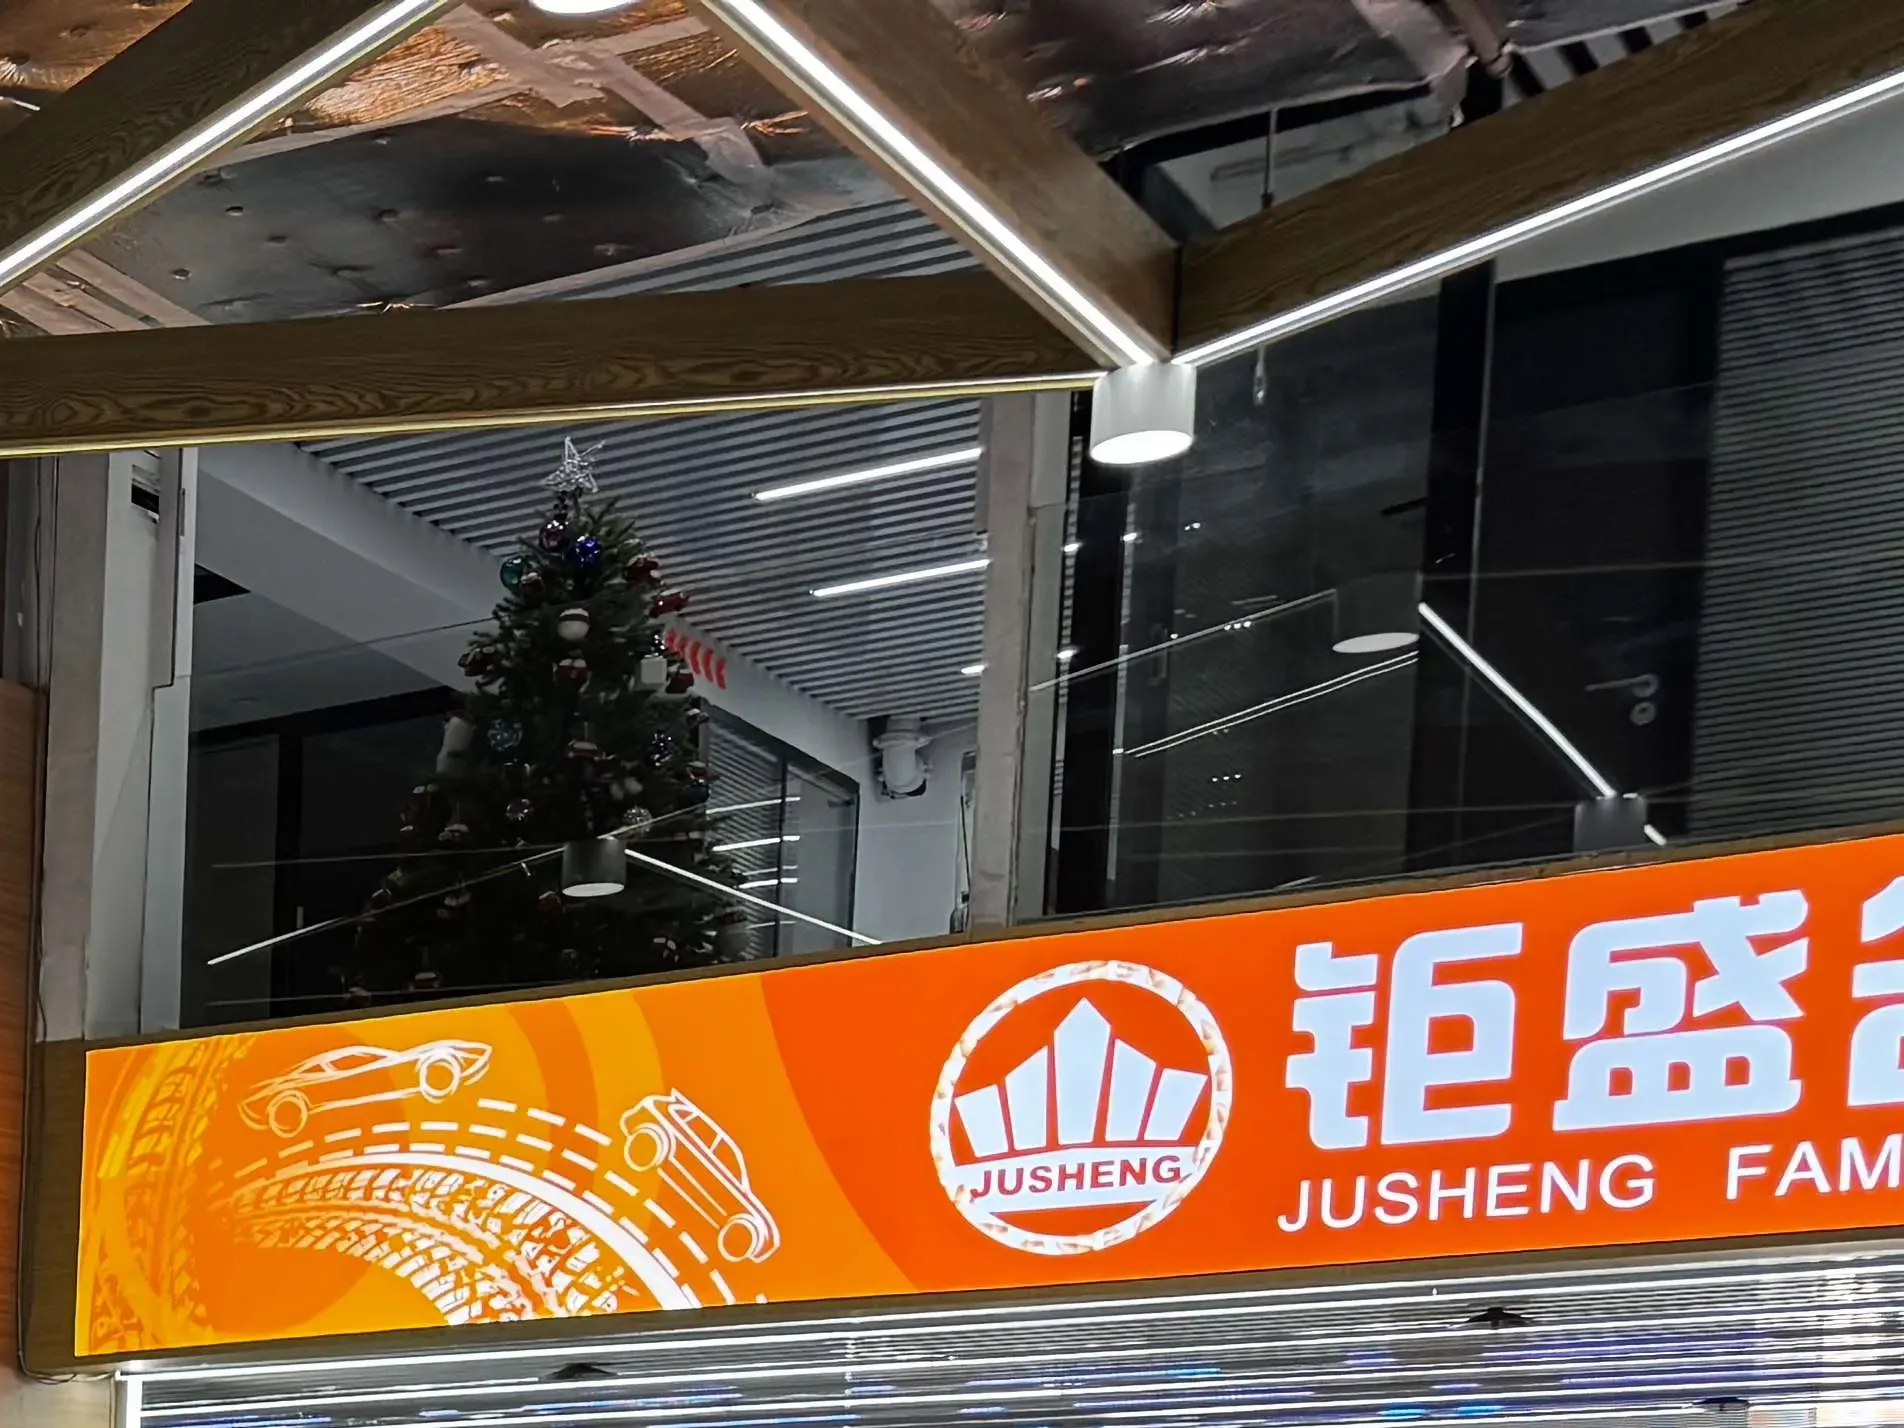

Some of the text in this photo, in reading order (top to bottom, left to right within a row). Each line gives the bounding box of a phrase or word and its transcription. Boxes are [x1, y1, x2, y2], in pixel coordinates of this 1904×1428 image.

[1285, 875, 1904, 1150] 钜盛
[970, 1155, 1182, 1202] JUSHENG
[1277, 1153, 1655, 1233] JUSHENG
